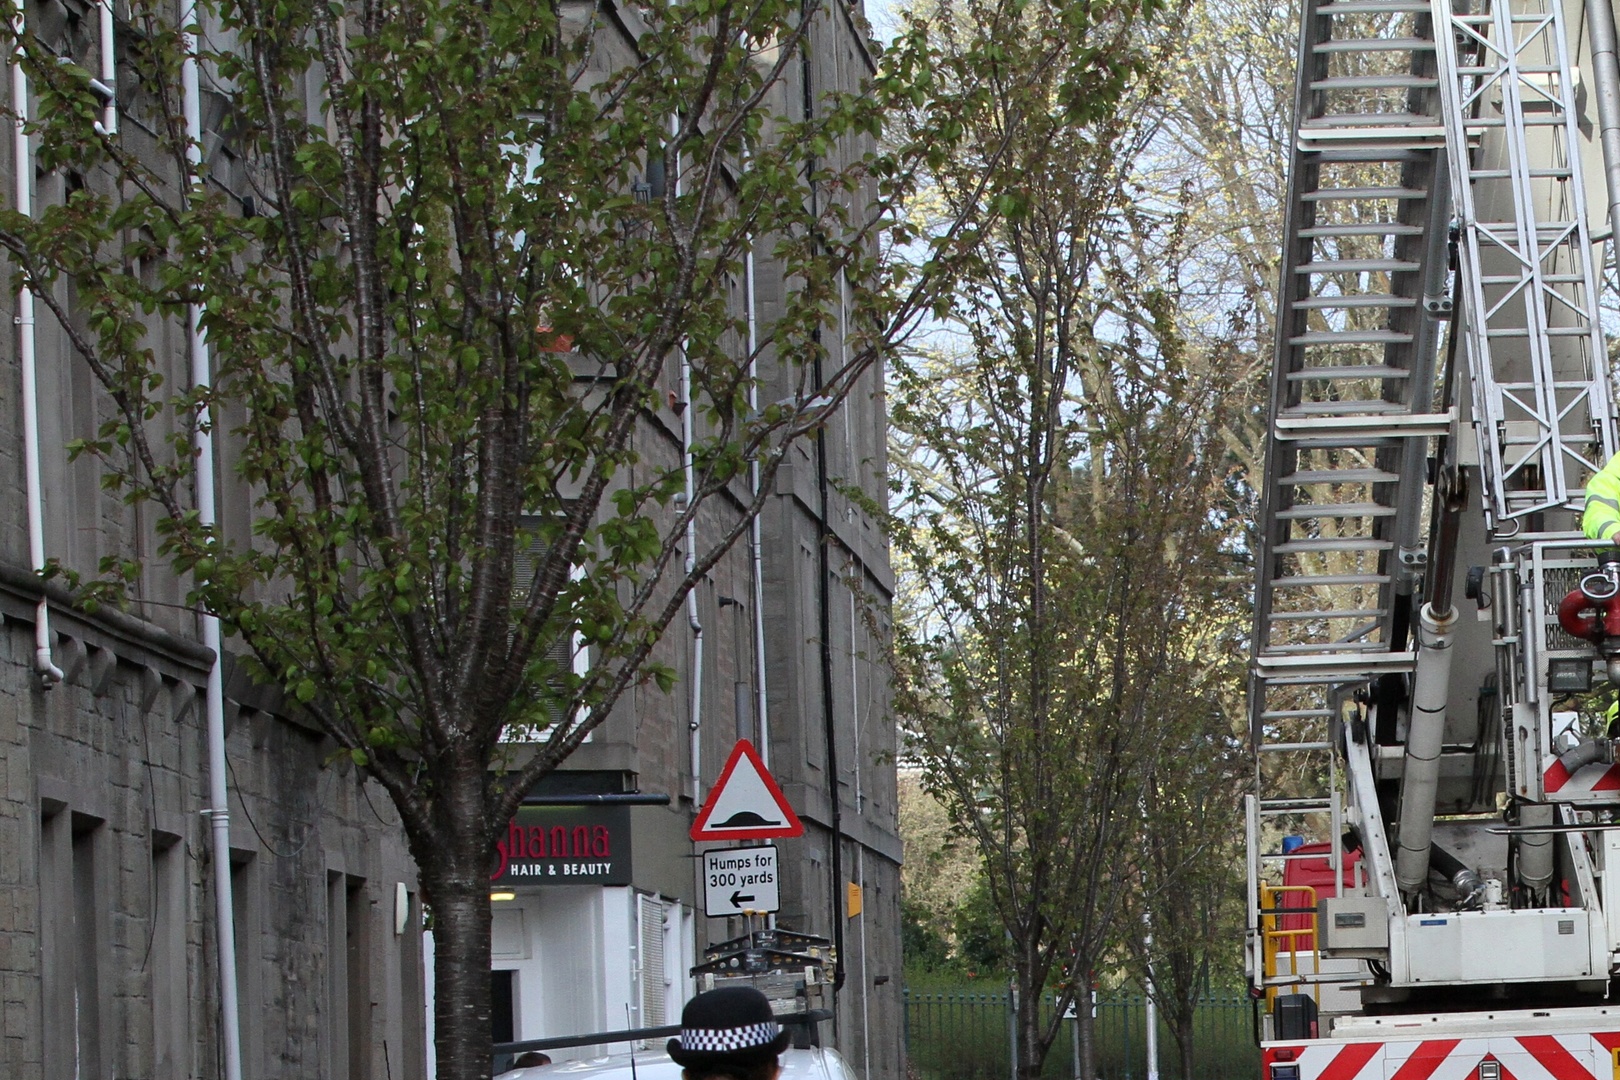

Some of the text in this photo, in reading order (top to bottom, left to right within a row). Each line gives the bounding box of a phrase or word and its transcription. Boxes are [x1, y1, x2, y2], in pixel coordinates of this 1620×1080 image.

[510, 862, 611, 876] HAIR & BEAUTY
[709, 854, 772, 871] Humps for
[710, 871, 773, 888] 300 yards
